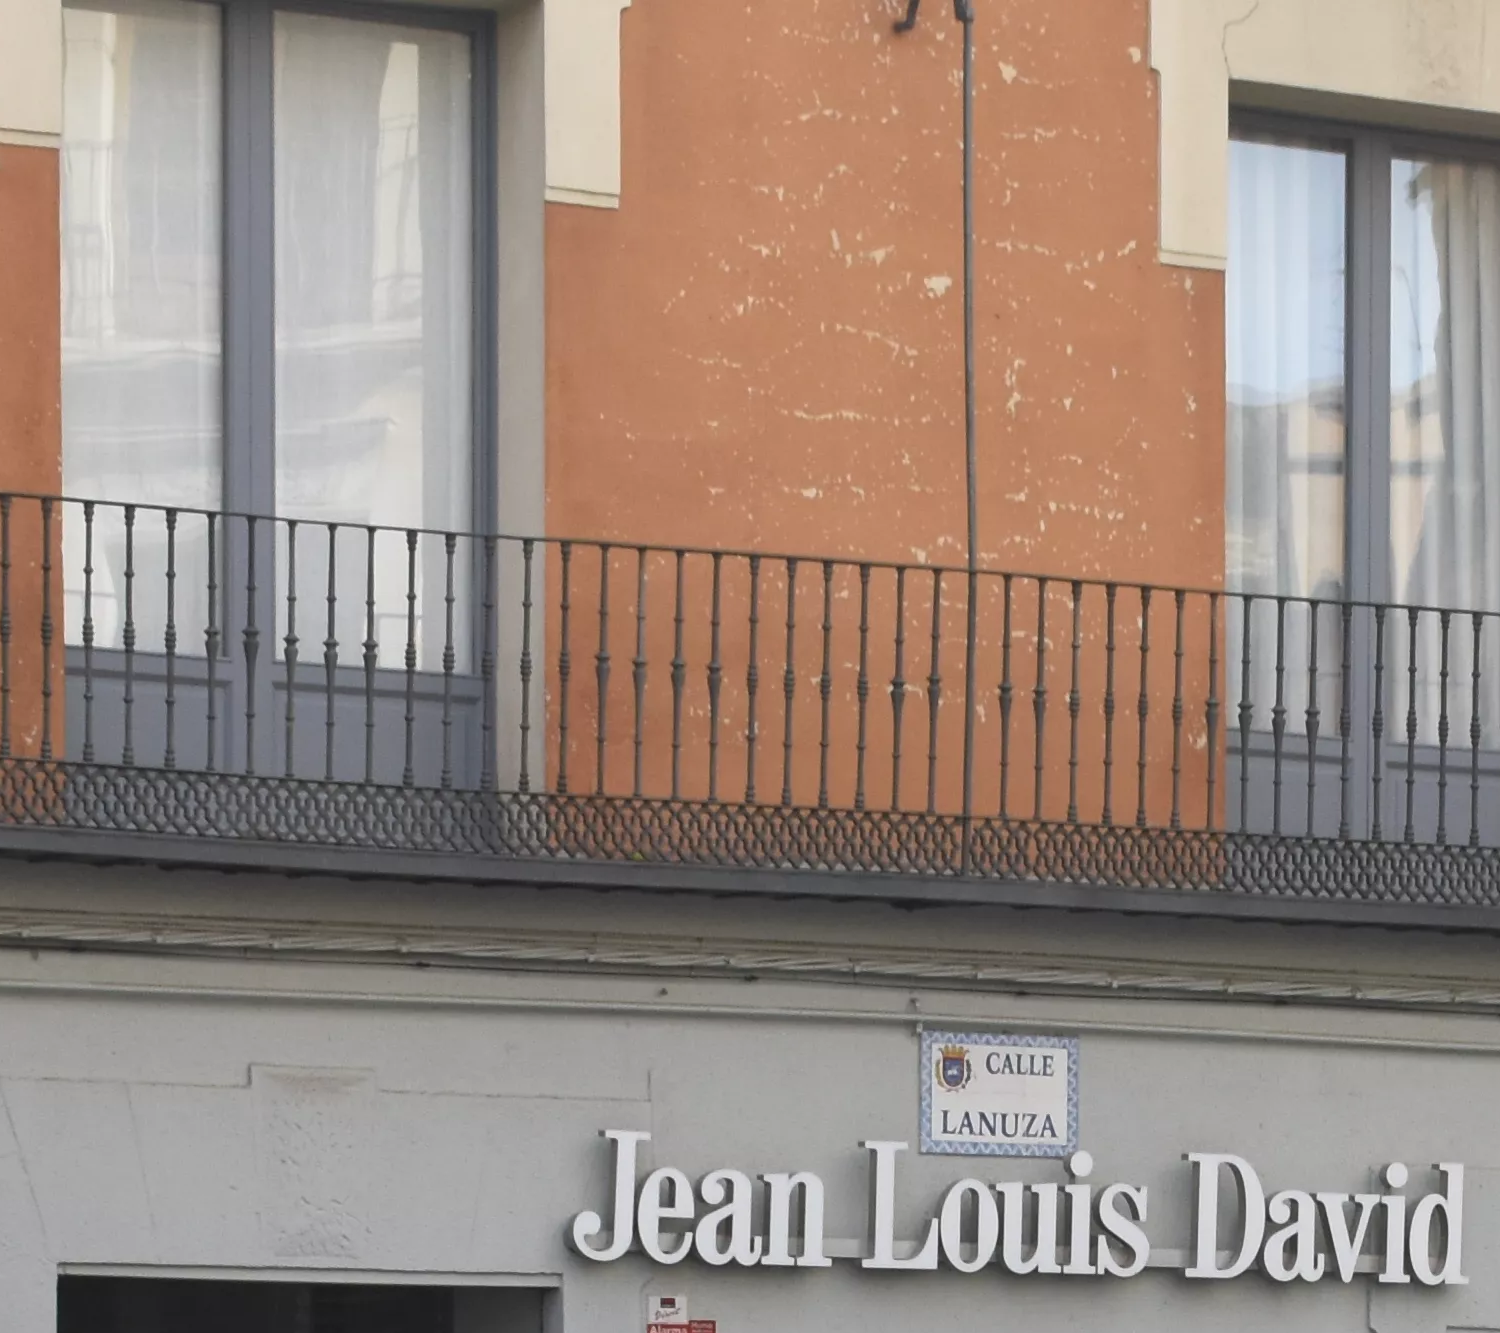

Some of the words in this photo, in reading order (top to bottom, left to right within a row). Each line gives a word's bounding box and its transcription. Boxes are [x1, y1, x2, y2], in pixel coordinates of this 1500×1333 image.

[985, 1052, 1054, 1077] CALLE
[940, 1109, 1058, 1138] LANUZA
[571, 1129, 833, 1267] Jean
[859, 1140, 1151, 1278] Louis
[1185, 1152, 1469, 1286] David
